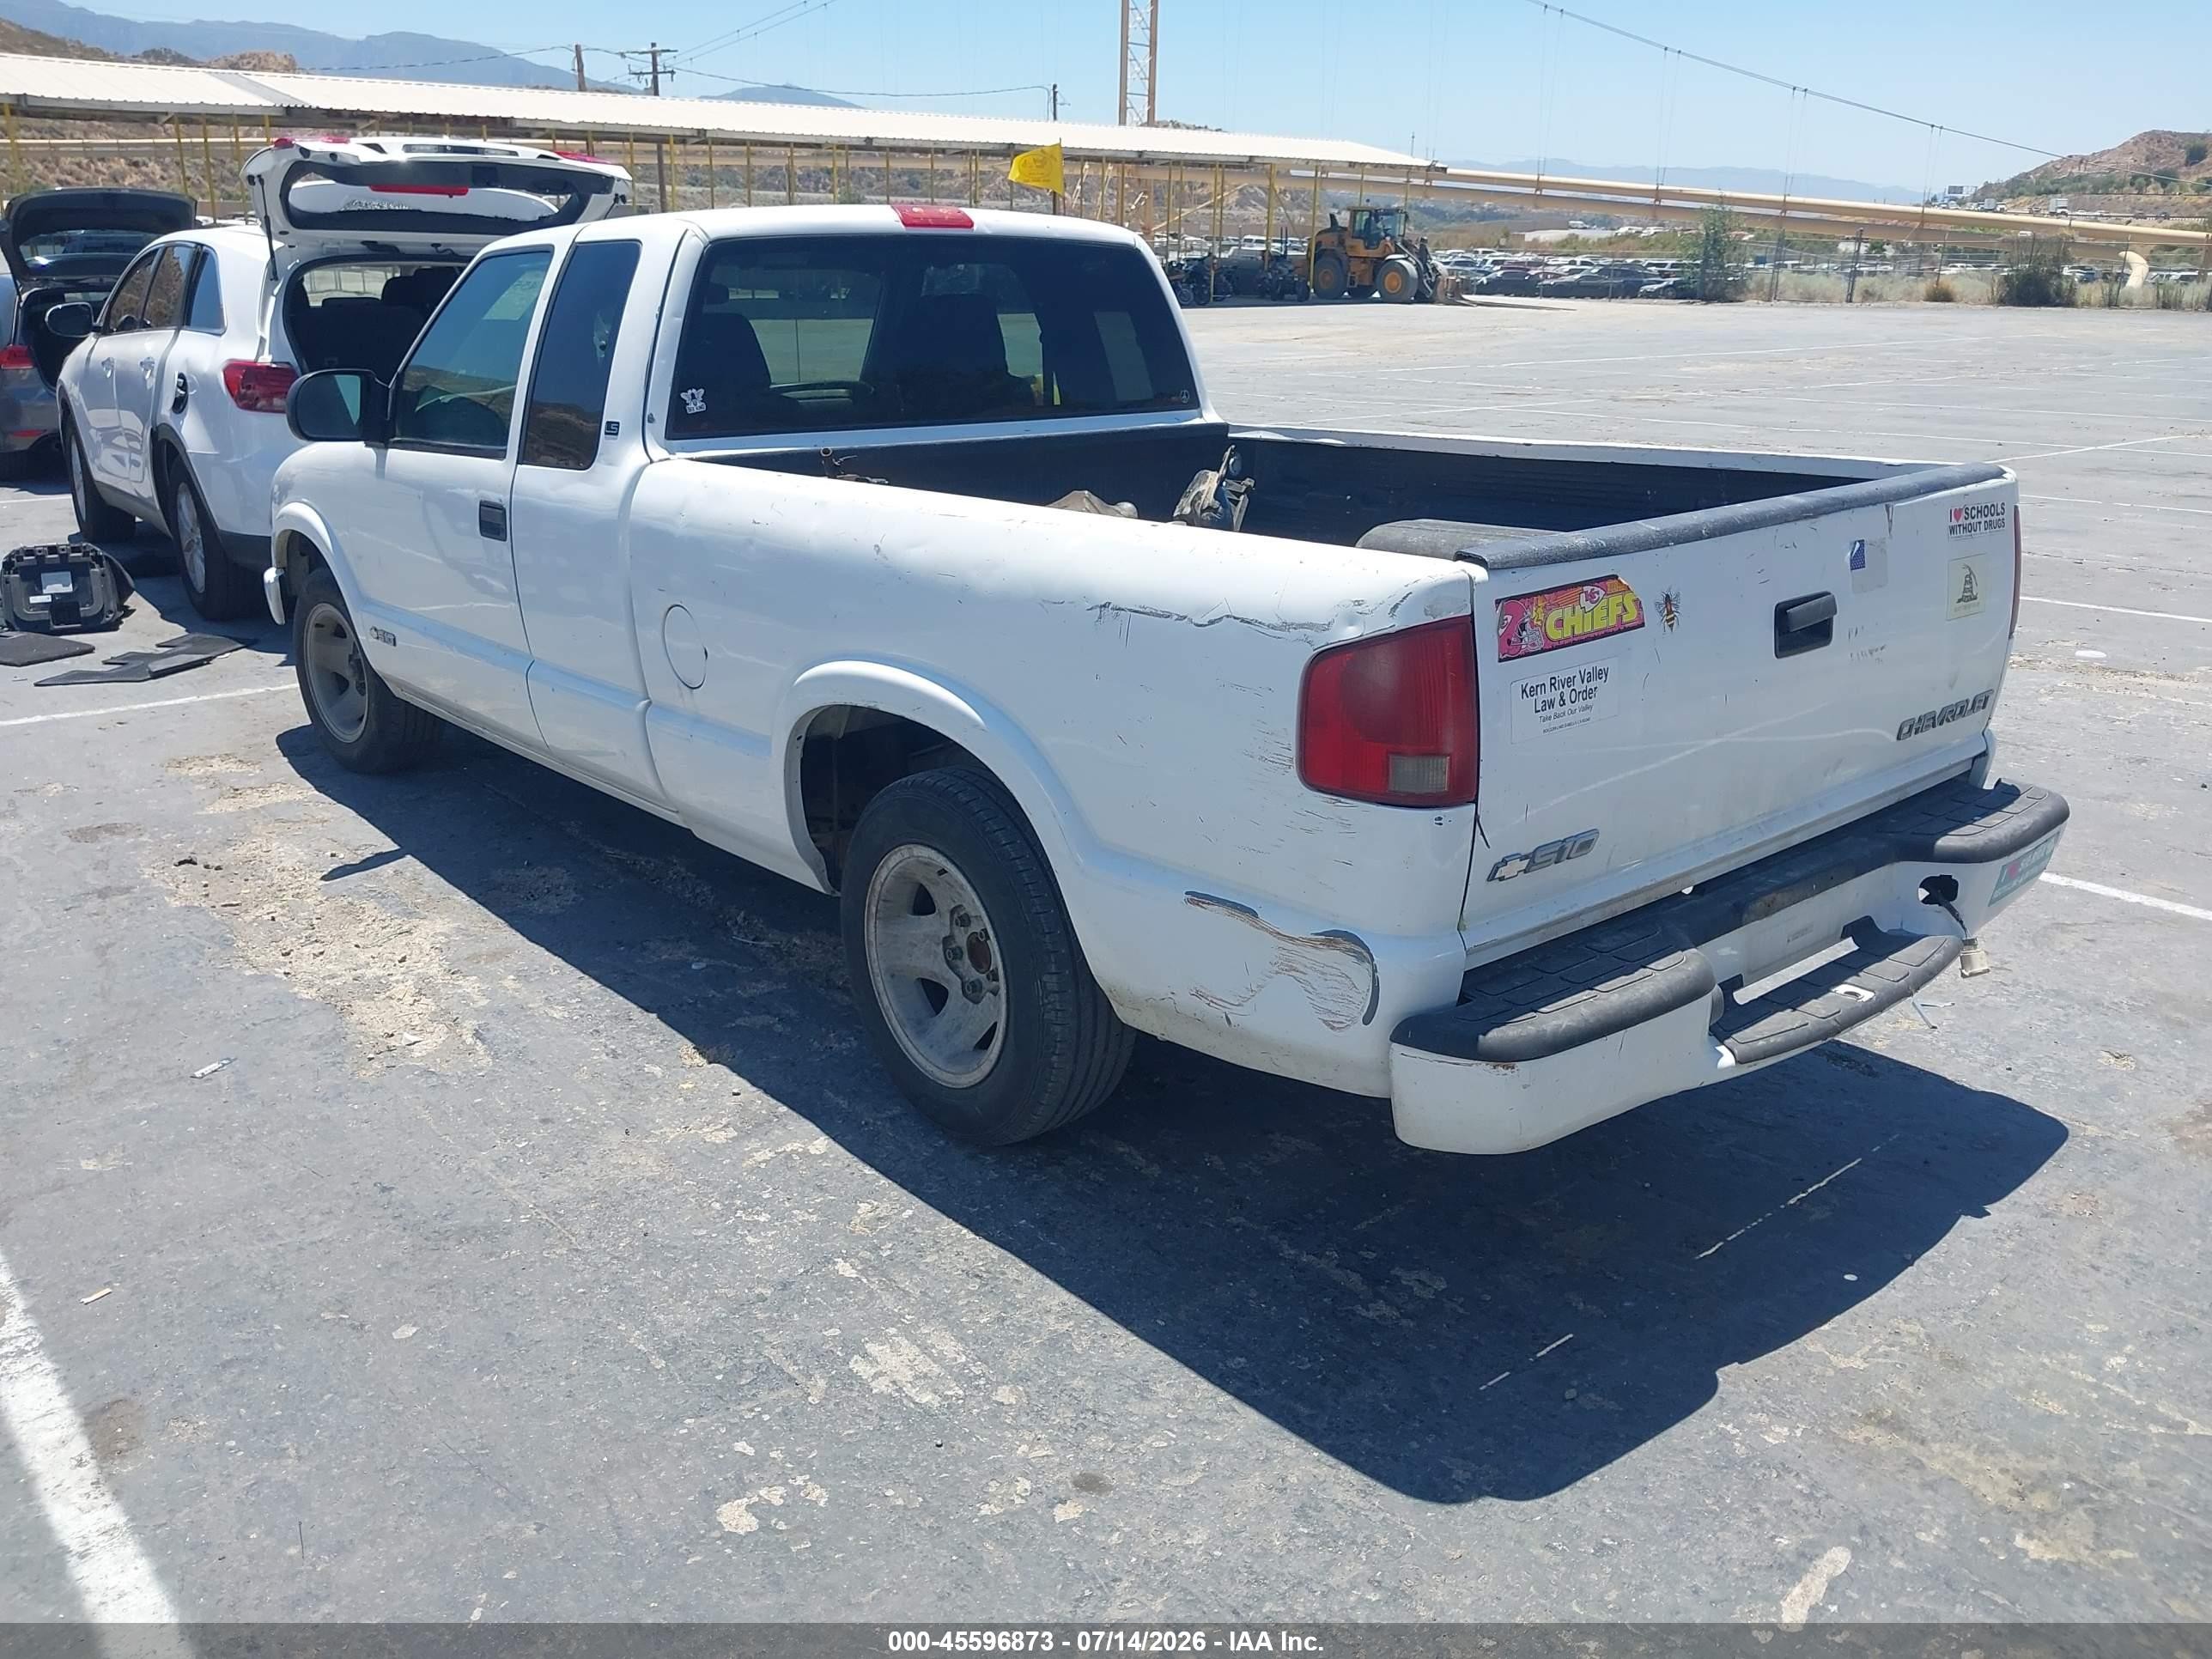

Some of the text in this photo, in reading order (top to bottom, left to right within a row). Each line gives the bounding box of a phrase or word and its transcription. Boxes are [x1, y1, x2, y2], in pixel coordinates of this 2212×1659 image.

[1949, 501, 2006, 523] I SCHOOLS
[1949, 518, 2006, 536] WITHOUT DRUGS
[1545, 592, 1638, 641] CHIEFS
[1521, 665, 1609, 700] Kern River Valley
[1534, 685, 1598, 714] Law & Order
[1539, 704, 1594, 724] Take Back Our Valley
[1896, 689, 1995, 741] CHEVROLET
[1524, 829, 1599, 874] S10
